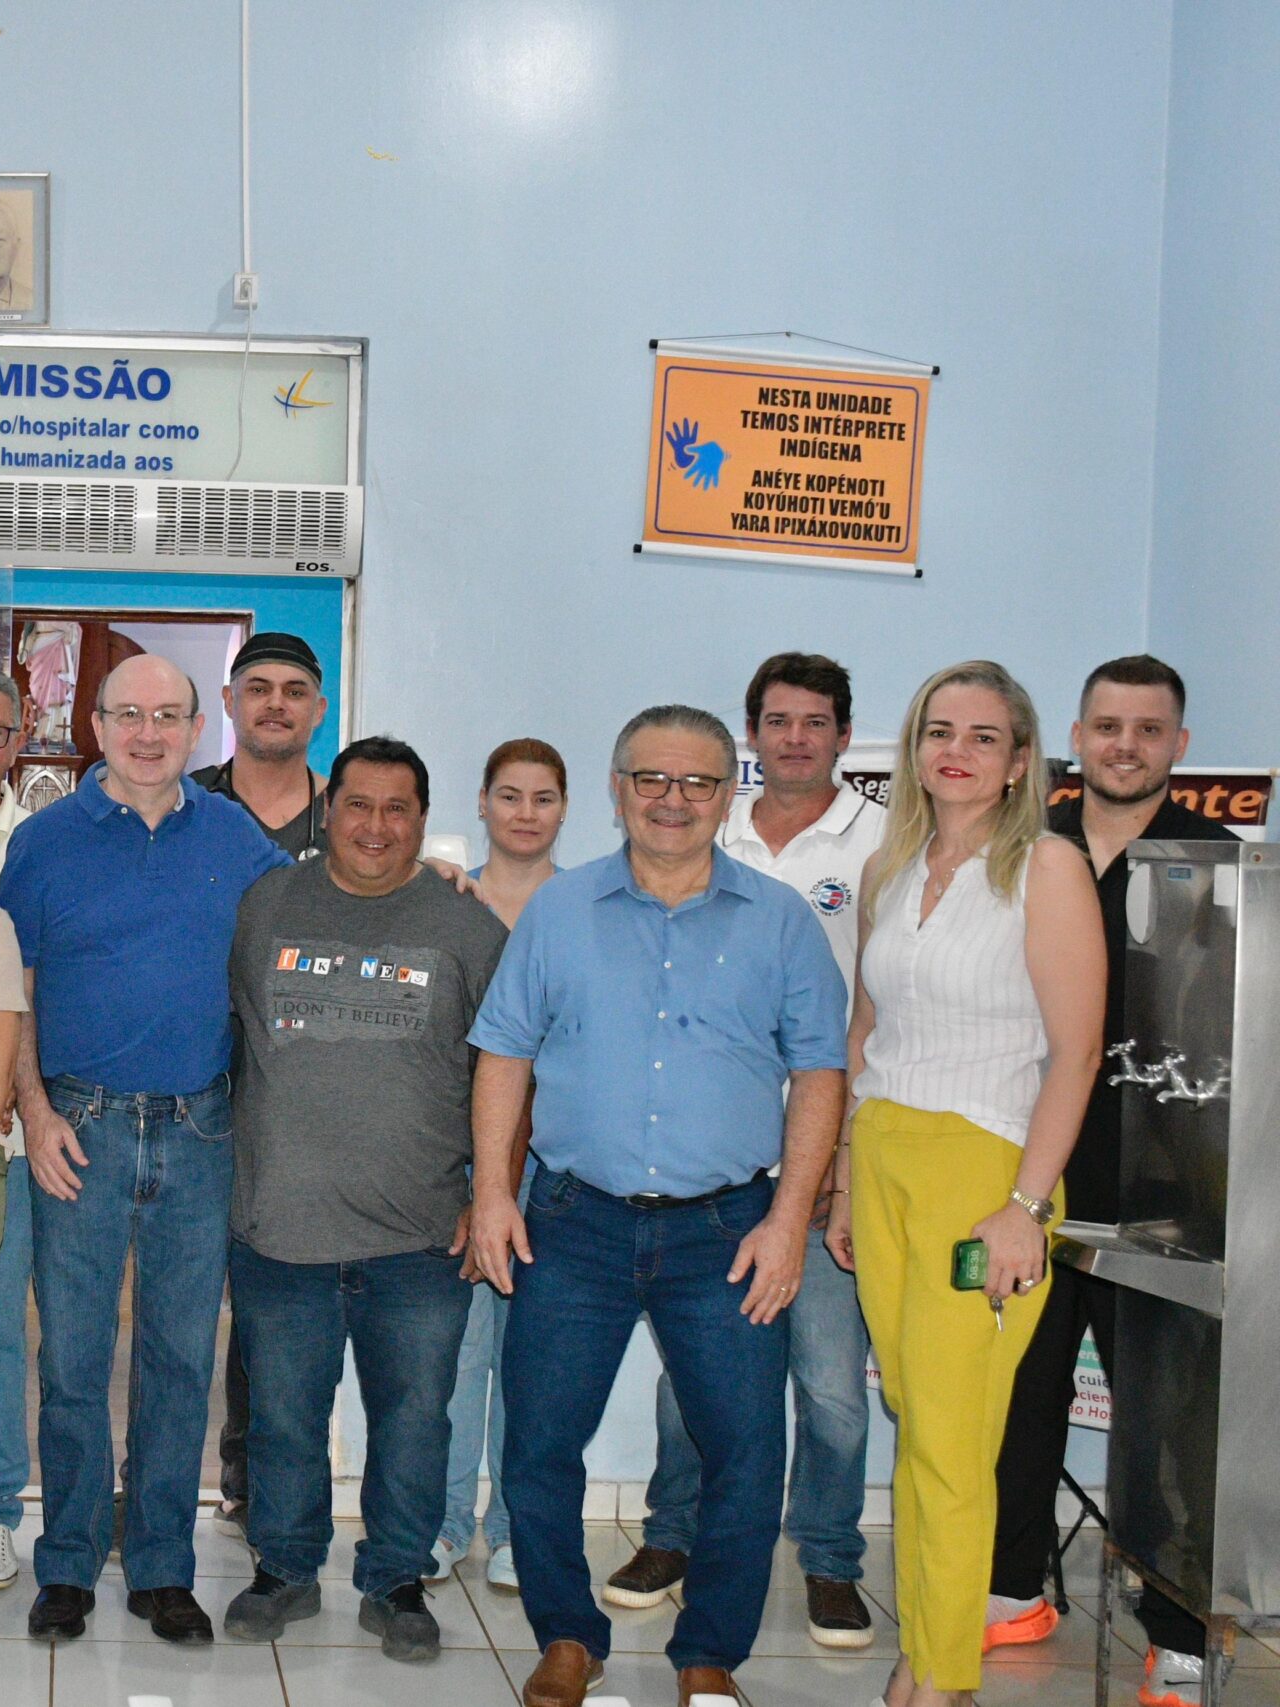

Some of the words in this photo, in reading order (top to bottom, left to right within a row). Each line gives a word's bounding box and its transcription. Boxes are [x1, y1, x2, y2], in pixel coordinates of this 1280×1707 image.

[758, 386, 811, 409] NESTA
[816, 391, 893, 416] UNIDADE
[138, 423, 200, 441] como
[740, 410, 800, 432] TEMOS
[803, 414, 907, 441] INTÉRPRETE
[0, 447, 126, 470] humanizada
[134, 455, 174, 472] aos
[780, 437, 862, 462] INDÍGENA
[751, 469, 801, 491] ANÉYE
[805, 474, 885, 497] KOPÉNOTI
[743, 491, 825, 515] KOYÚHOTI
[731, 512, 770, 533] YARA
[774, 516, 902, 544] IPIXÁXOVOKUTI
[351, 1009, 425, 1032] BELIEVE
